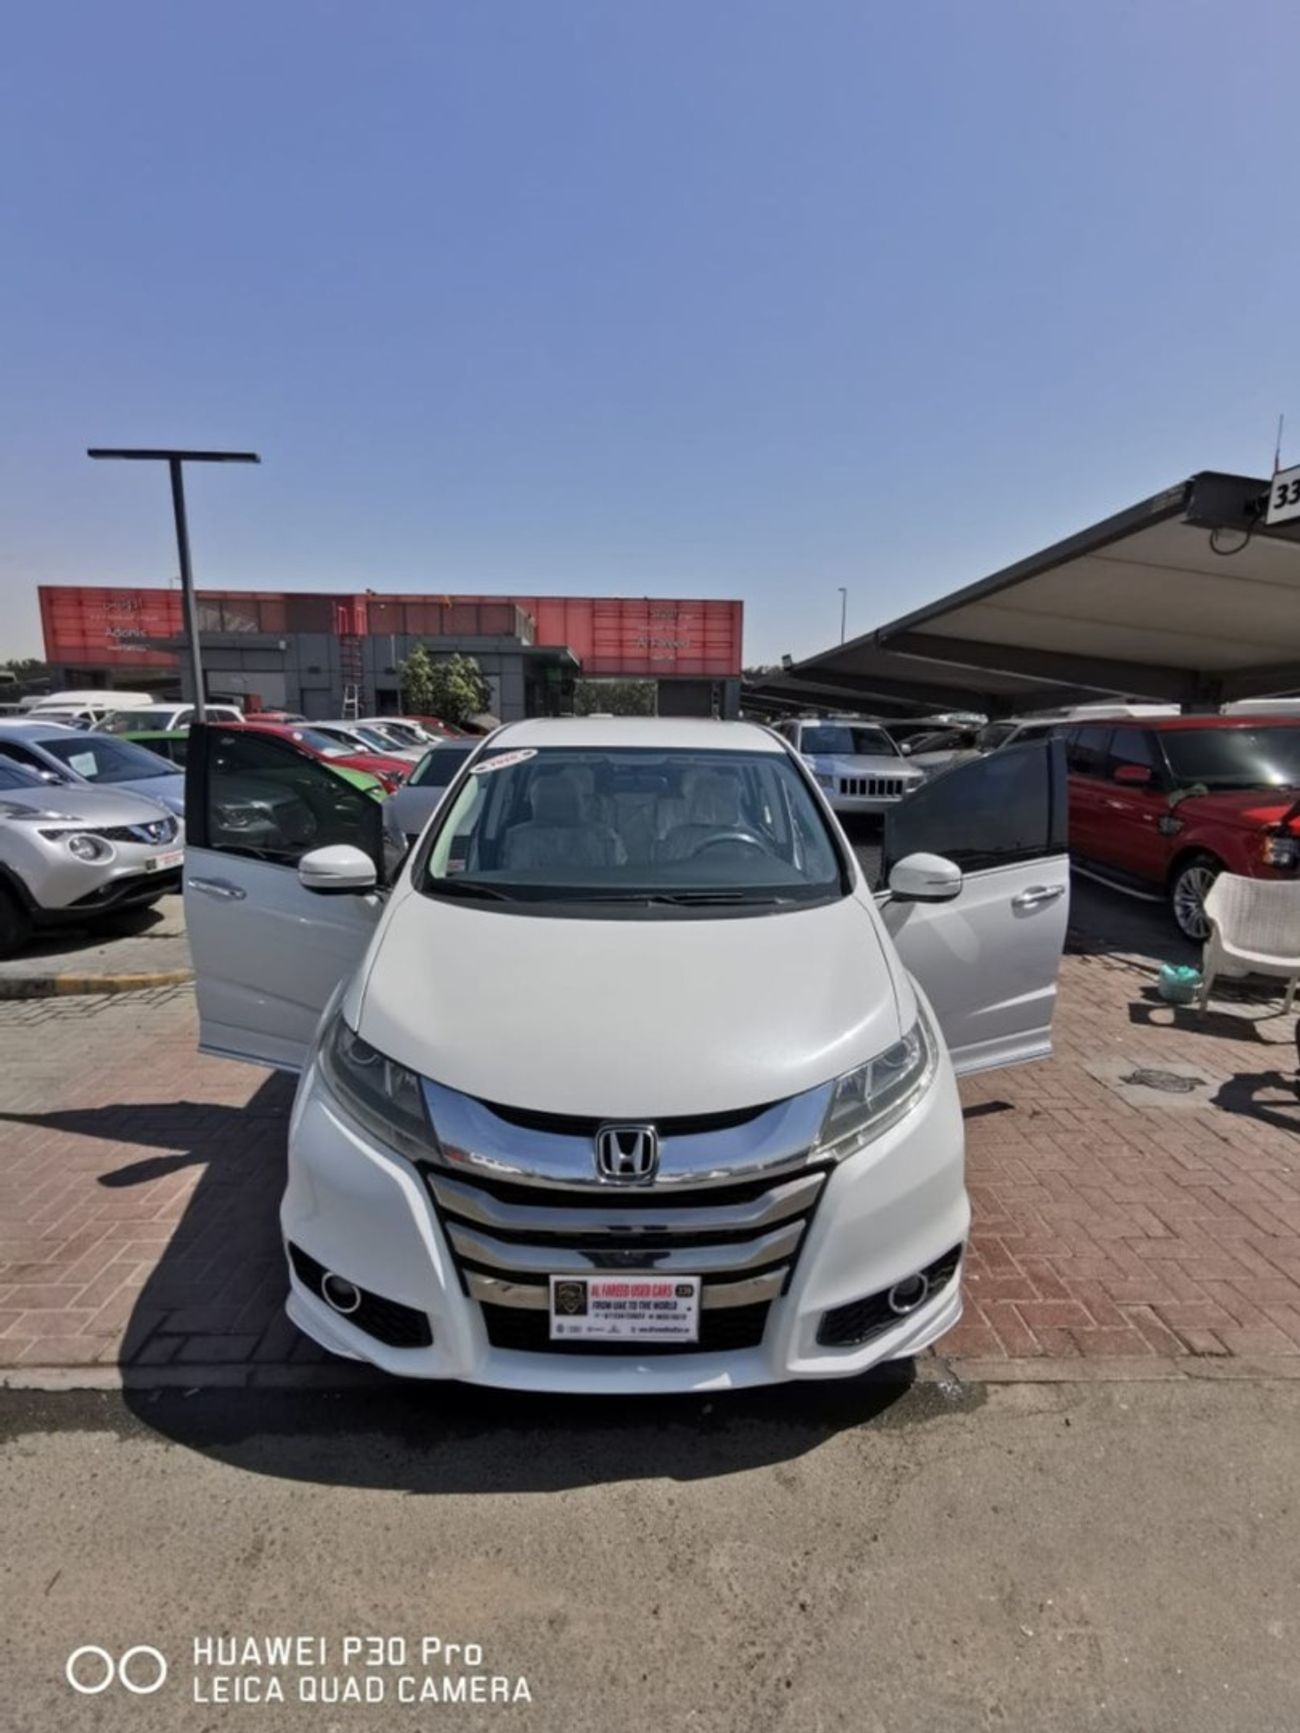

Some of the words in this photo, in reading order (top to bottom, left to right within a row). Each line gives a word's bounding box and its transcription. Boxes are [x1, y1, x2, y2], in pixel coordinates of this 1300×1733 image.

[631, 1284, 651, 1297] USED
[652, 1284, 673, 1298] CARS
[593, 1301, 612, 1310] FROM
[613, 1301, 626, 1310] UAE
[628, 1301, 638, 1310] TO
[639, 1301, 652, 1310] THE
[653, 1301, 677, 1311] WORLD
